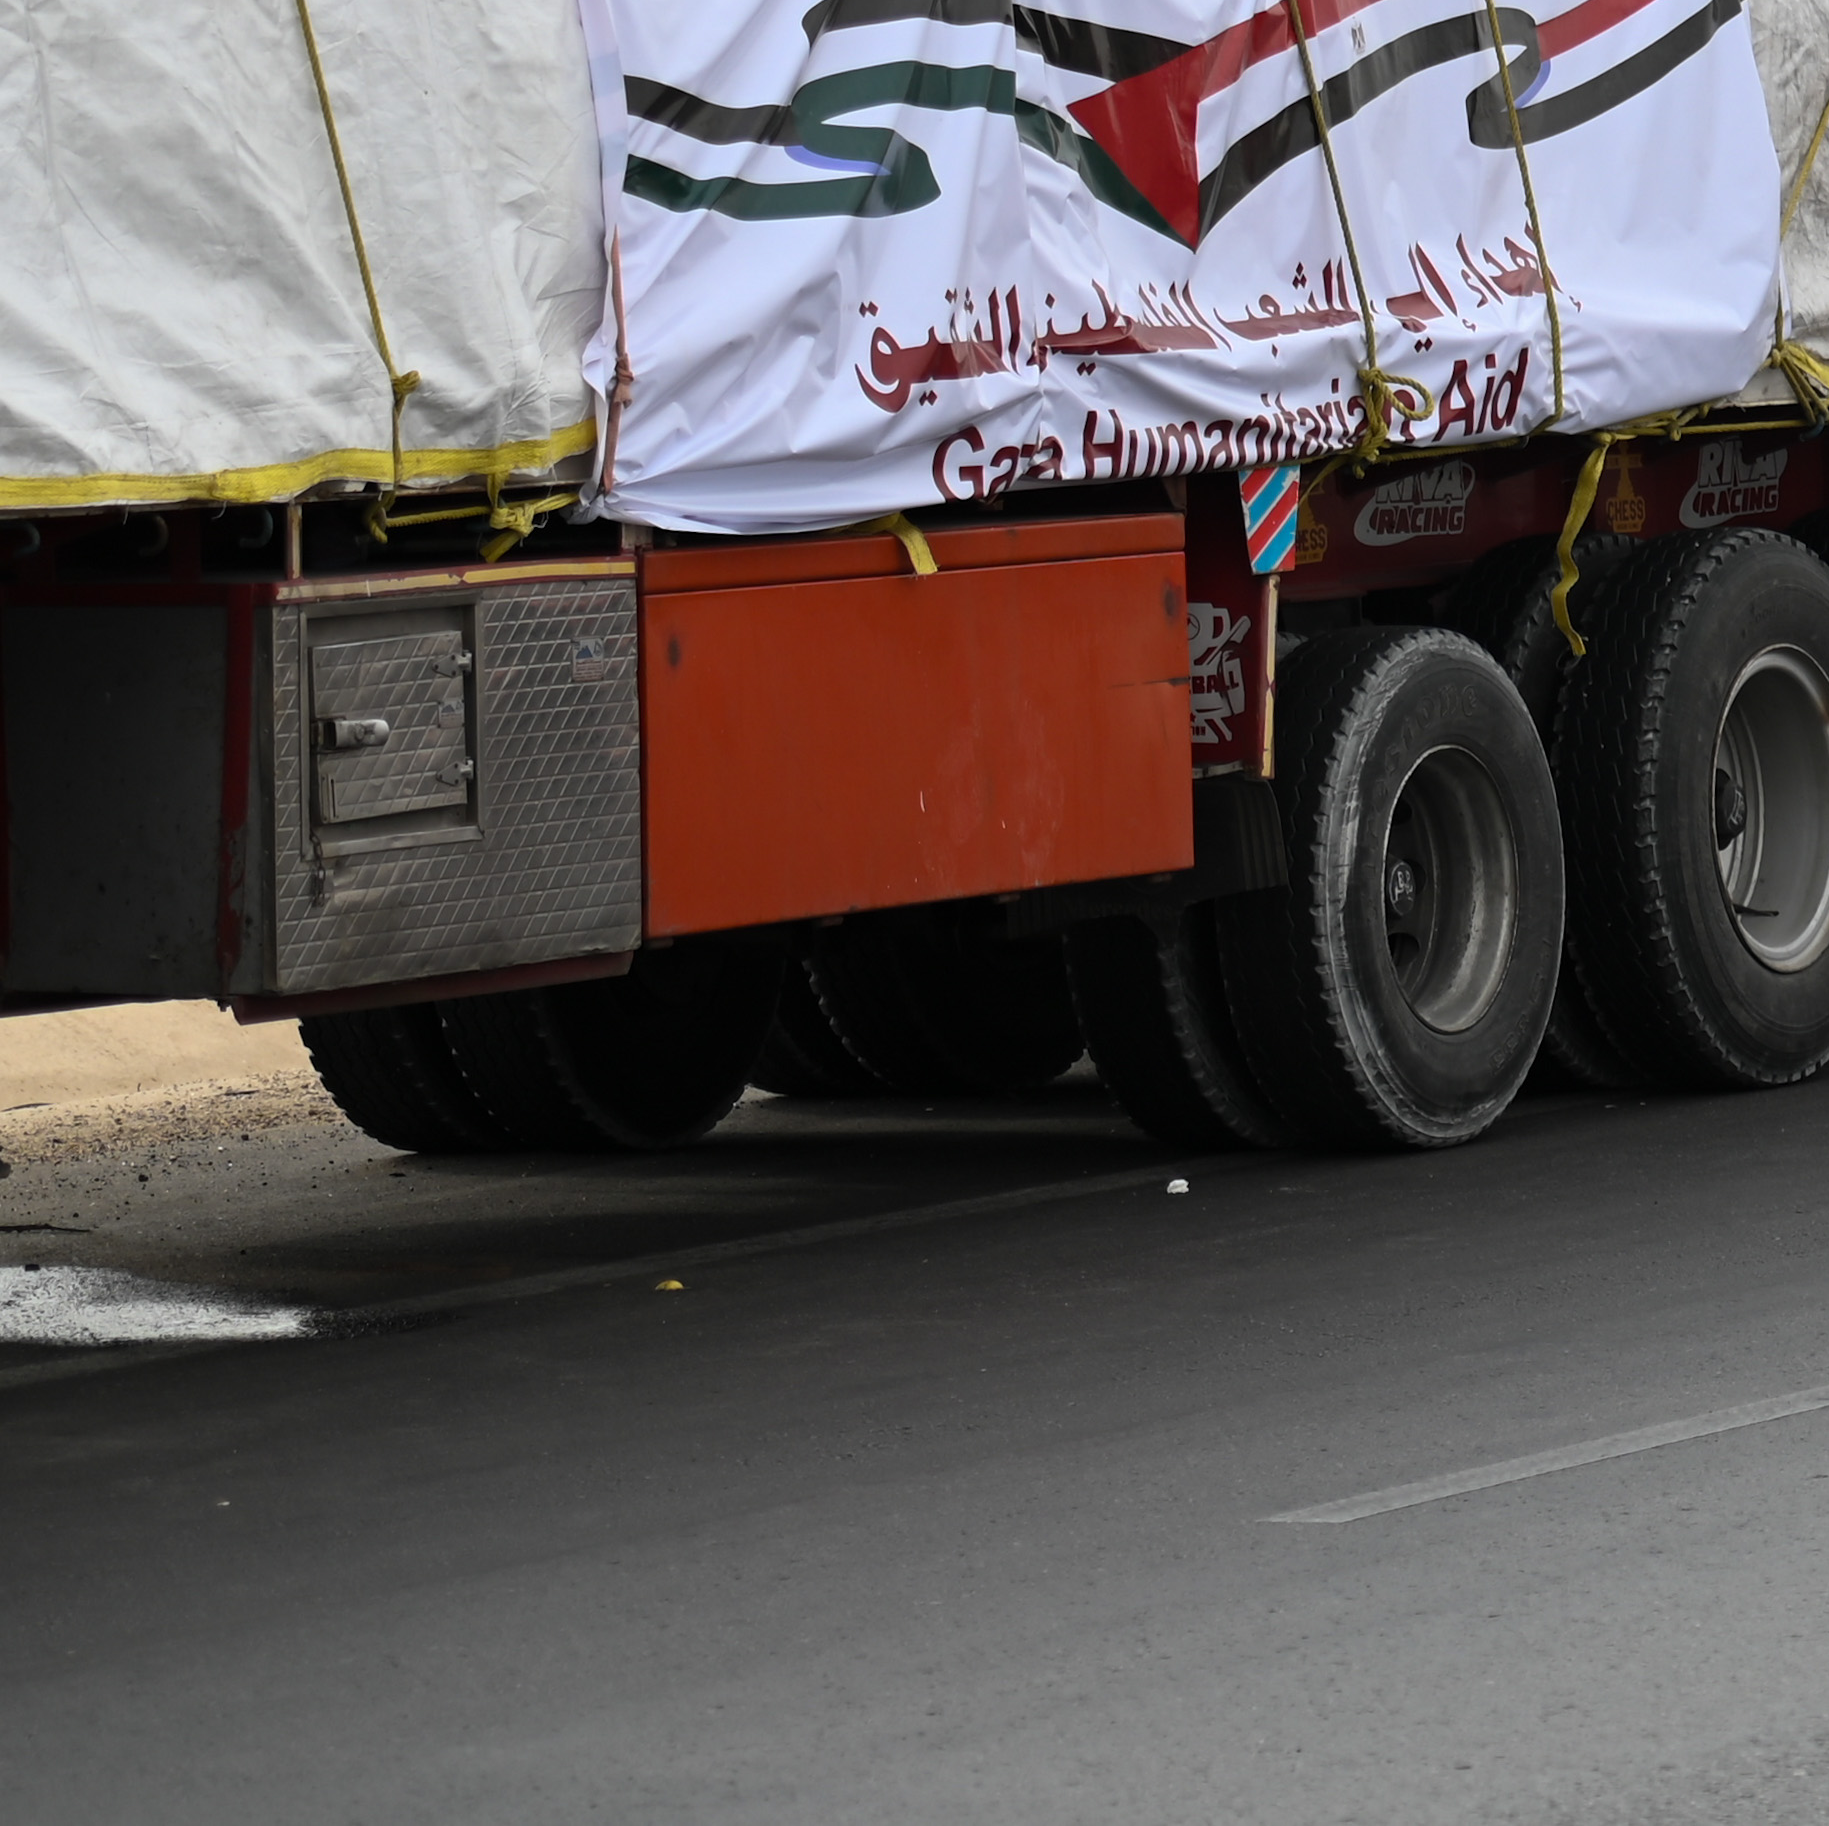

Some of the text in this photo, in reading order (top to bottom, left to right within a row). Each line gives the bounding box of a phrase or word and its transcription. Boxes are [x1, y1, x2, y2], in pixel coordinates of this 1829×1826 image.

[931, 346, 1530, 504] Gaza Humanitarian Aid
[1605, 495, 1645, 523] CHESS
[1699, 485, 1777, 518] RACING
[1374, 505, 1465, 535] RACING
